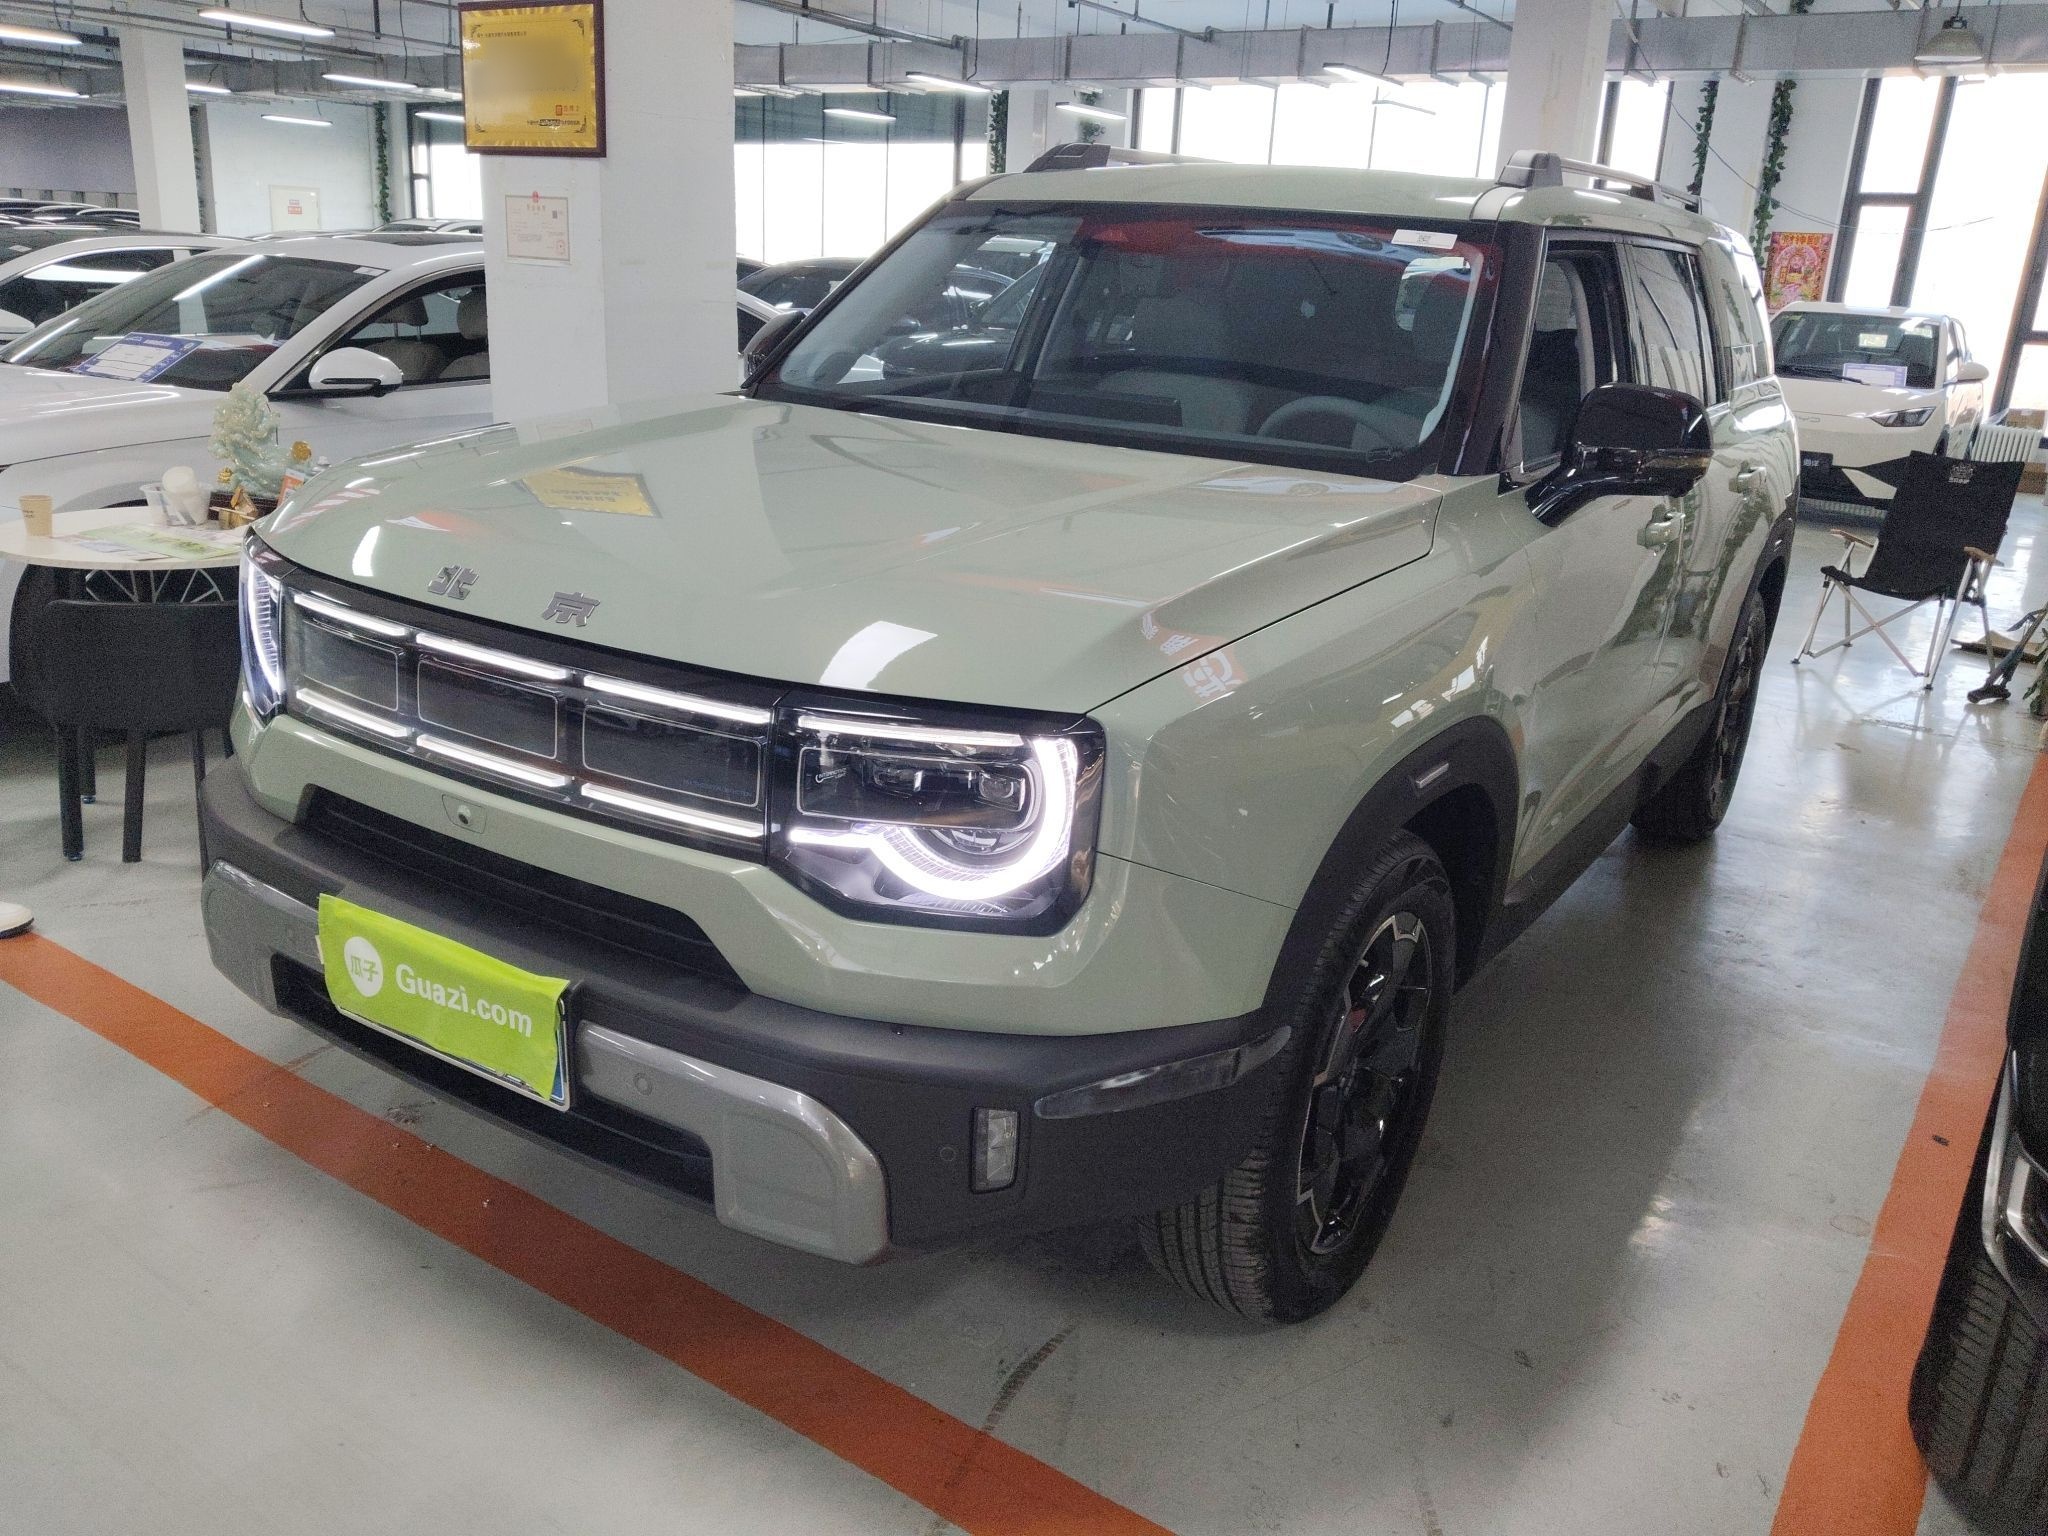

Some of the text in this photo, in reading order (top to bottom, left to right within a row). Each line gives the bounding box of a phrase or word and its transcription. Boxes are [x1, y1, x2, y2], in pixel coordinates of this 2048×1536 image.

[427, 564, 601, 627] 北京
[350, 954, 379, 983] 瓜子
[395, 963, 532, 1038] Guazi.com
